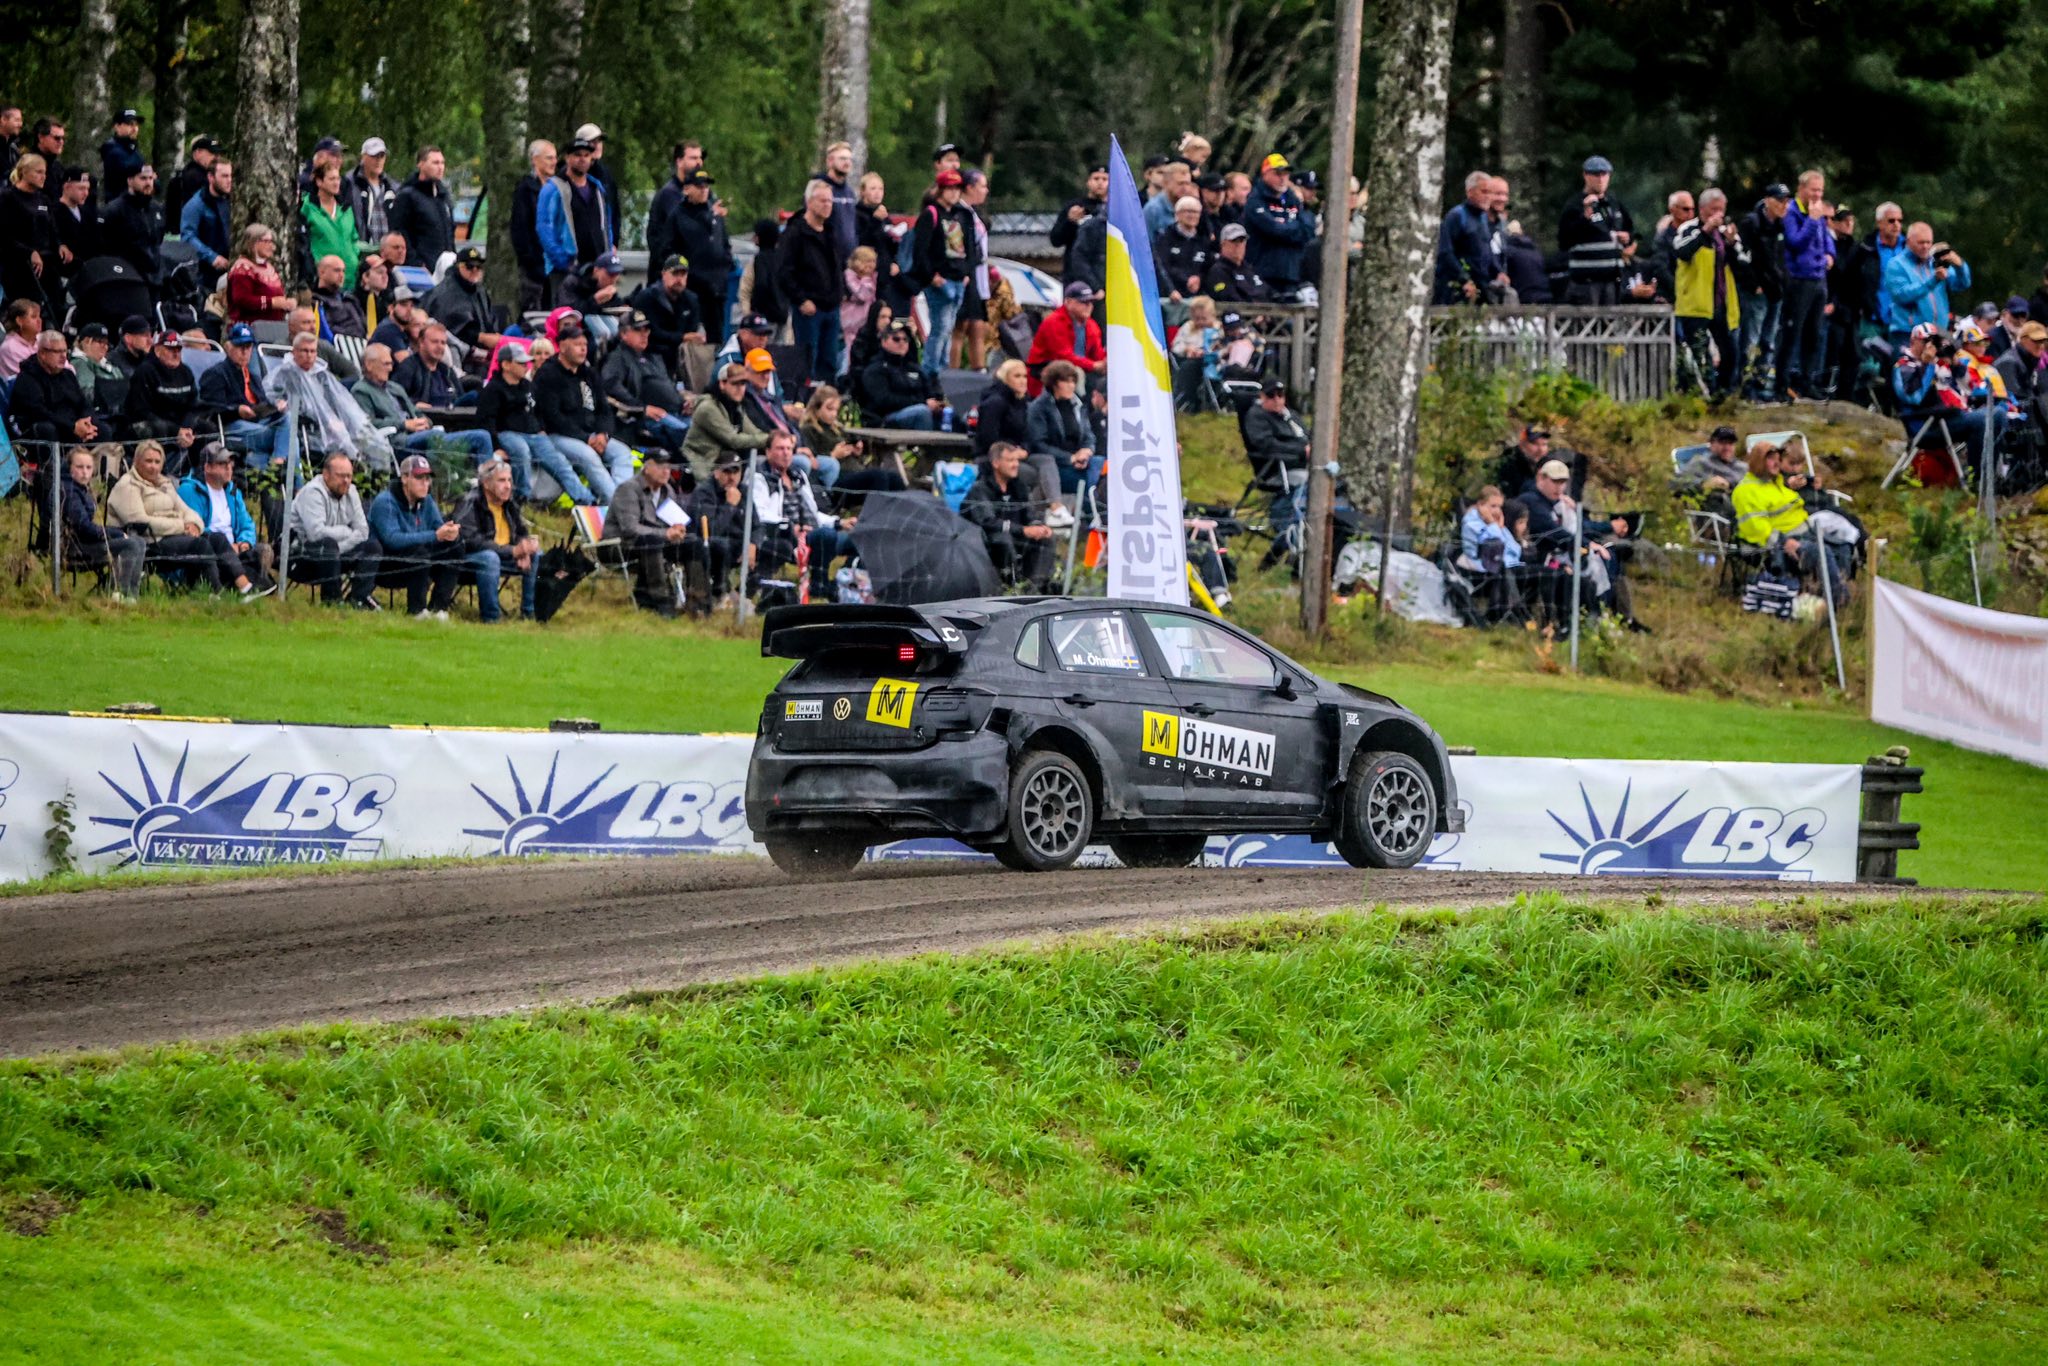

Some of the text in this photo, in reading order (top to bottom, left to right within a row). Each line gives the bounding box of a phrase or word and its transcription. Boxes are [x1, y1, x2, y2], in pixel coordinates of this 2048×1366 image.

[1101, 617, 1127, 654] 17
[1072, 652, 1124, 669] M. Öhman
[1148, 756, 1263, 787] SCHAKT AB
[241, 772, 397, 833] LBC
[608, 780, 747, 840] LBC
[1682, 806, 1827, 865] LBC
